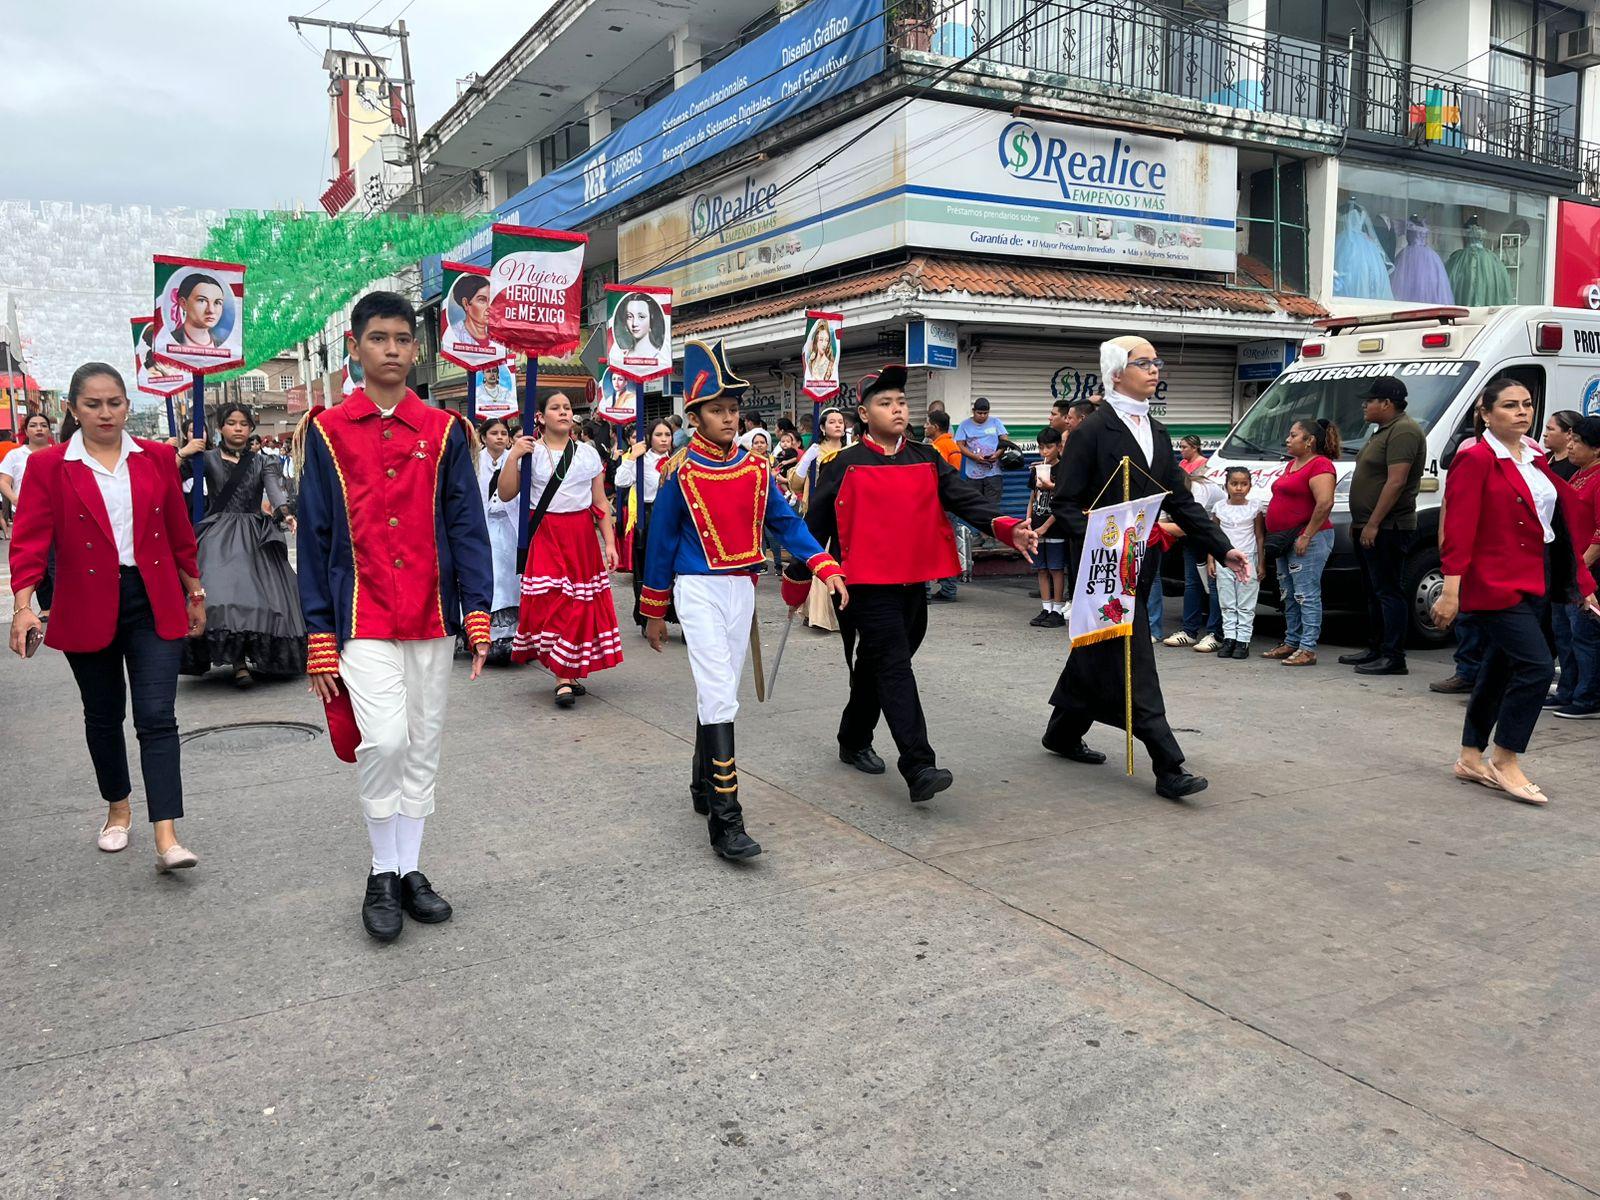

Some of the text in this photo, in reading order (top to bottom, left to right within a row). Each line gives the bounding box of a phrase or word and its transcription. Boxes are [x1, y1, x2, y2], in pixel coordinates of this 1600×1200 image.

[782, 16, 848, 66] Diseño Gráfico
[782, 73, 802, 99] Chef
[662, 75, 748, 136] Sistemas Computacionales
[696, 128, 706, 145] de
[706, 113, 737, 141] Sistemas
[738, 95, 772, 125] Digitales
[611, 145, 643, 179] CARRERAS
[1043, 137, 1167, 199] Realice
[711, 175, 777, 244] Realice
[946, 205, 983, 218] Préstamos
[983, 210, 1019, 221] prendarios
[1073, 188, 1166, 211] EMPEÑOS Y MÁS
[970, 230, 1008, 246] Garantía
[1009, 234, 1024, 246] de:
[1039, 240, 1058, 251] Mayor
[1059, 242, 1086, 252] Préstamo
[1087, 244, 1116, 254] Inmediato
[1144, 250, 1165, 259] Mejores
[499, 258, 568, 288] Mujeres
[505, 303, 566, 324] DE MÉXICO
[1280, 362, 1401, 385] PROTECCIÓN
[1401, 362, 1464, 376] CIVIL
